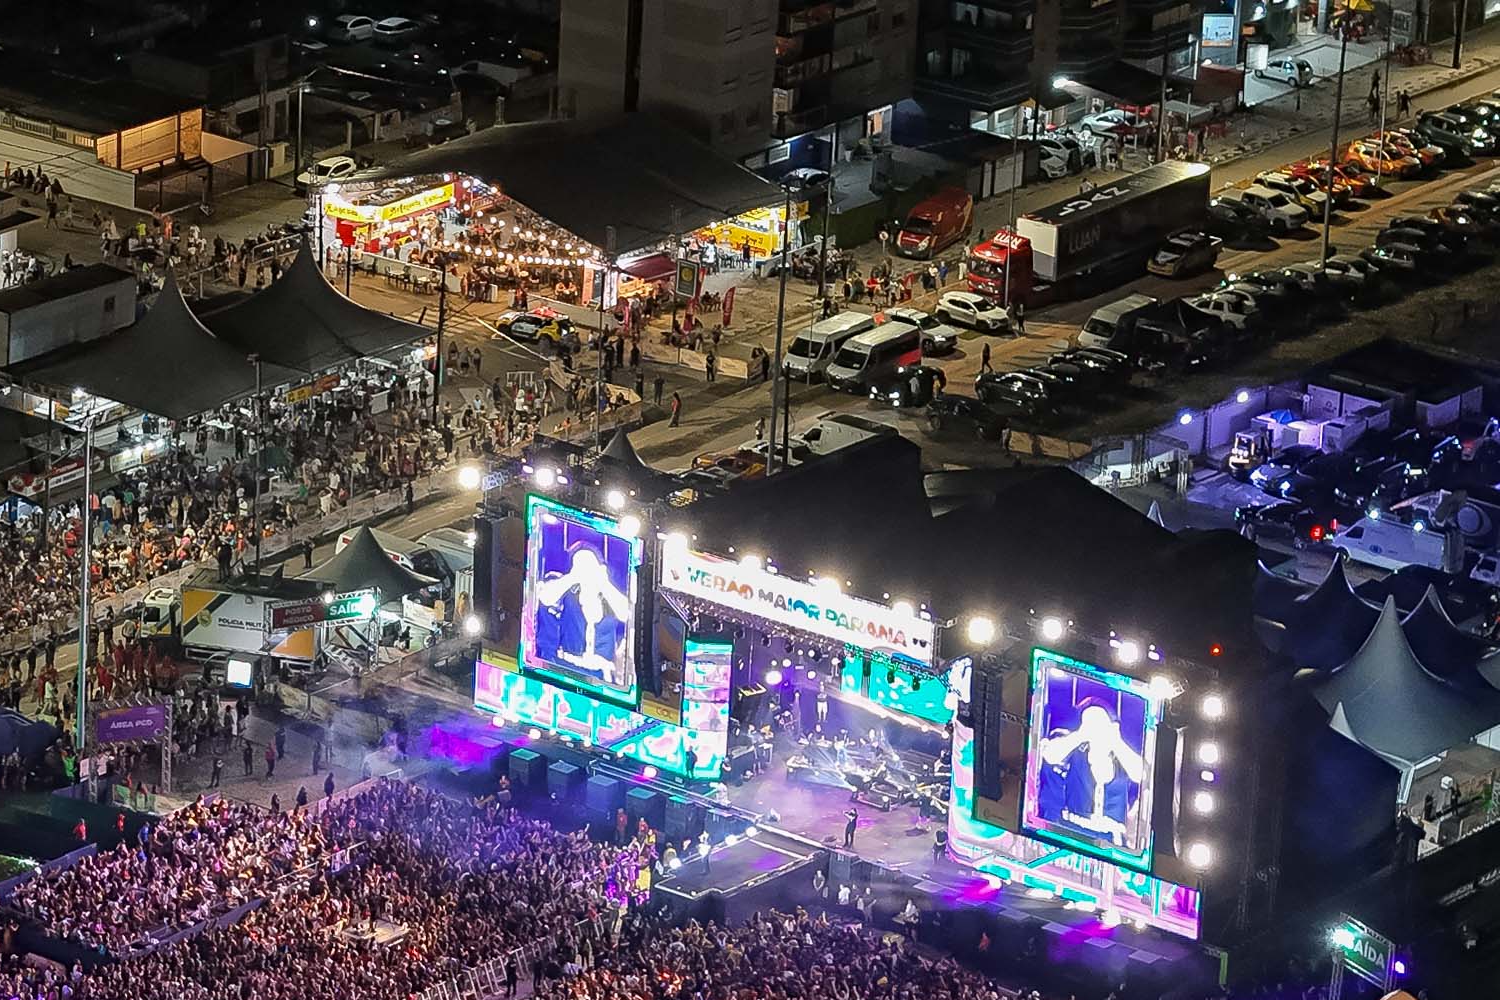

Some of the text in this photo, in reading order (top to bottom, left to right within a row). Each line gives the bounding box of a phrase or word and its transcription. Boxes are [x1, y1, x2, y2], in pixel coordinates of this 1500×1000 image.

[993, 230, 1023, 250] LUAN
[1068, 225, 1102, 254] LUAN
[284, 605, 313, 616] POSTO
[757, 589, 821, 621] MAIOR
